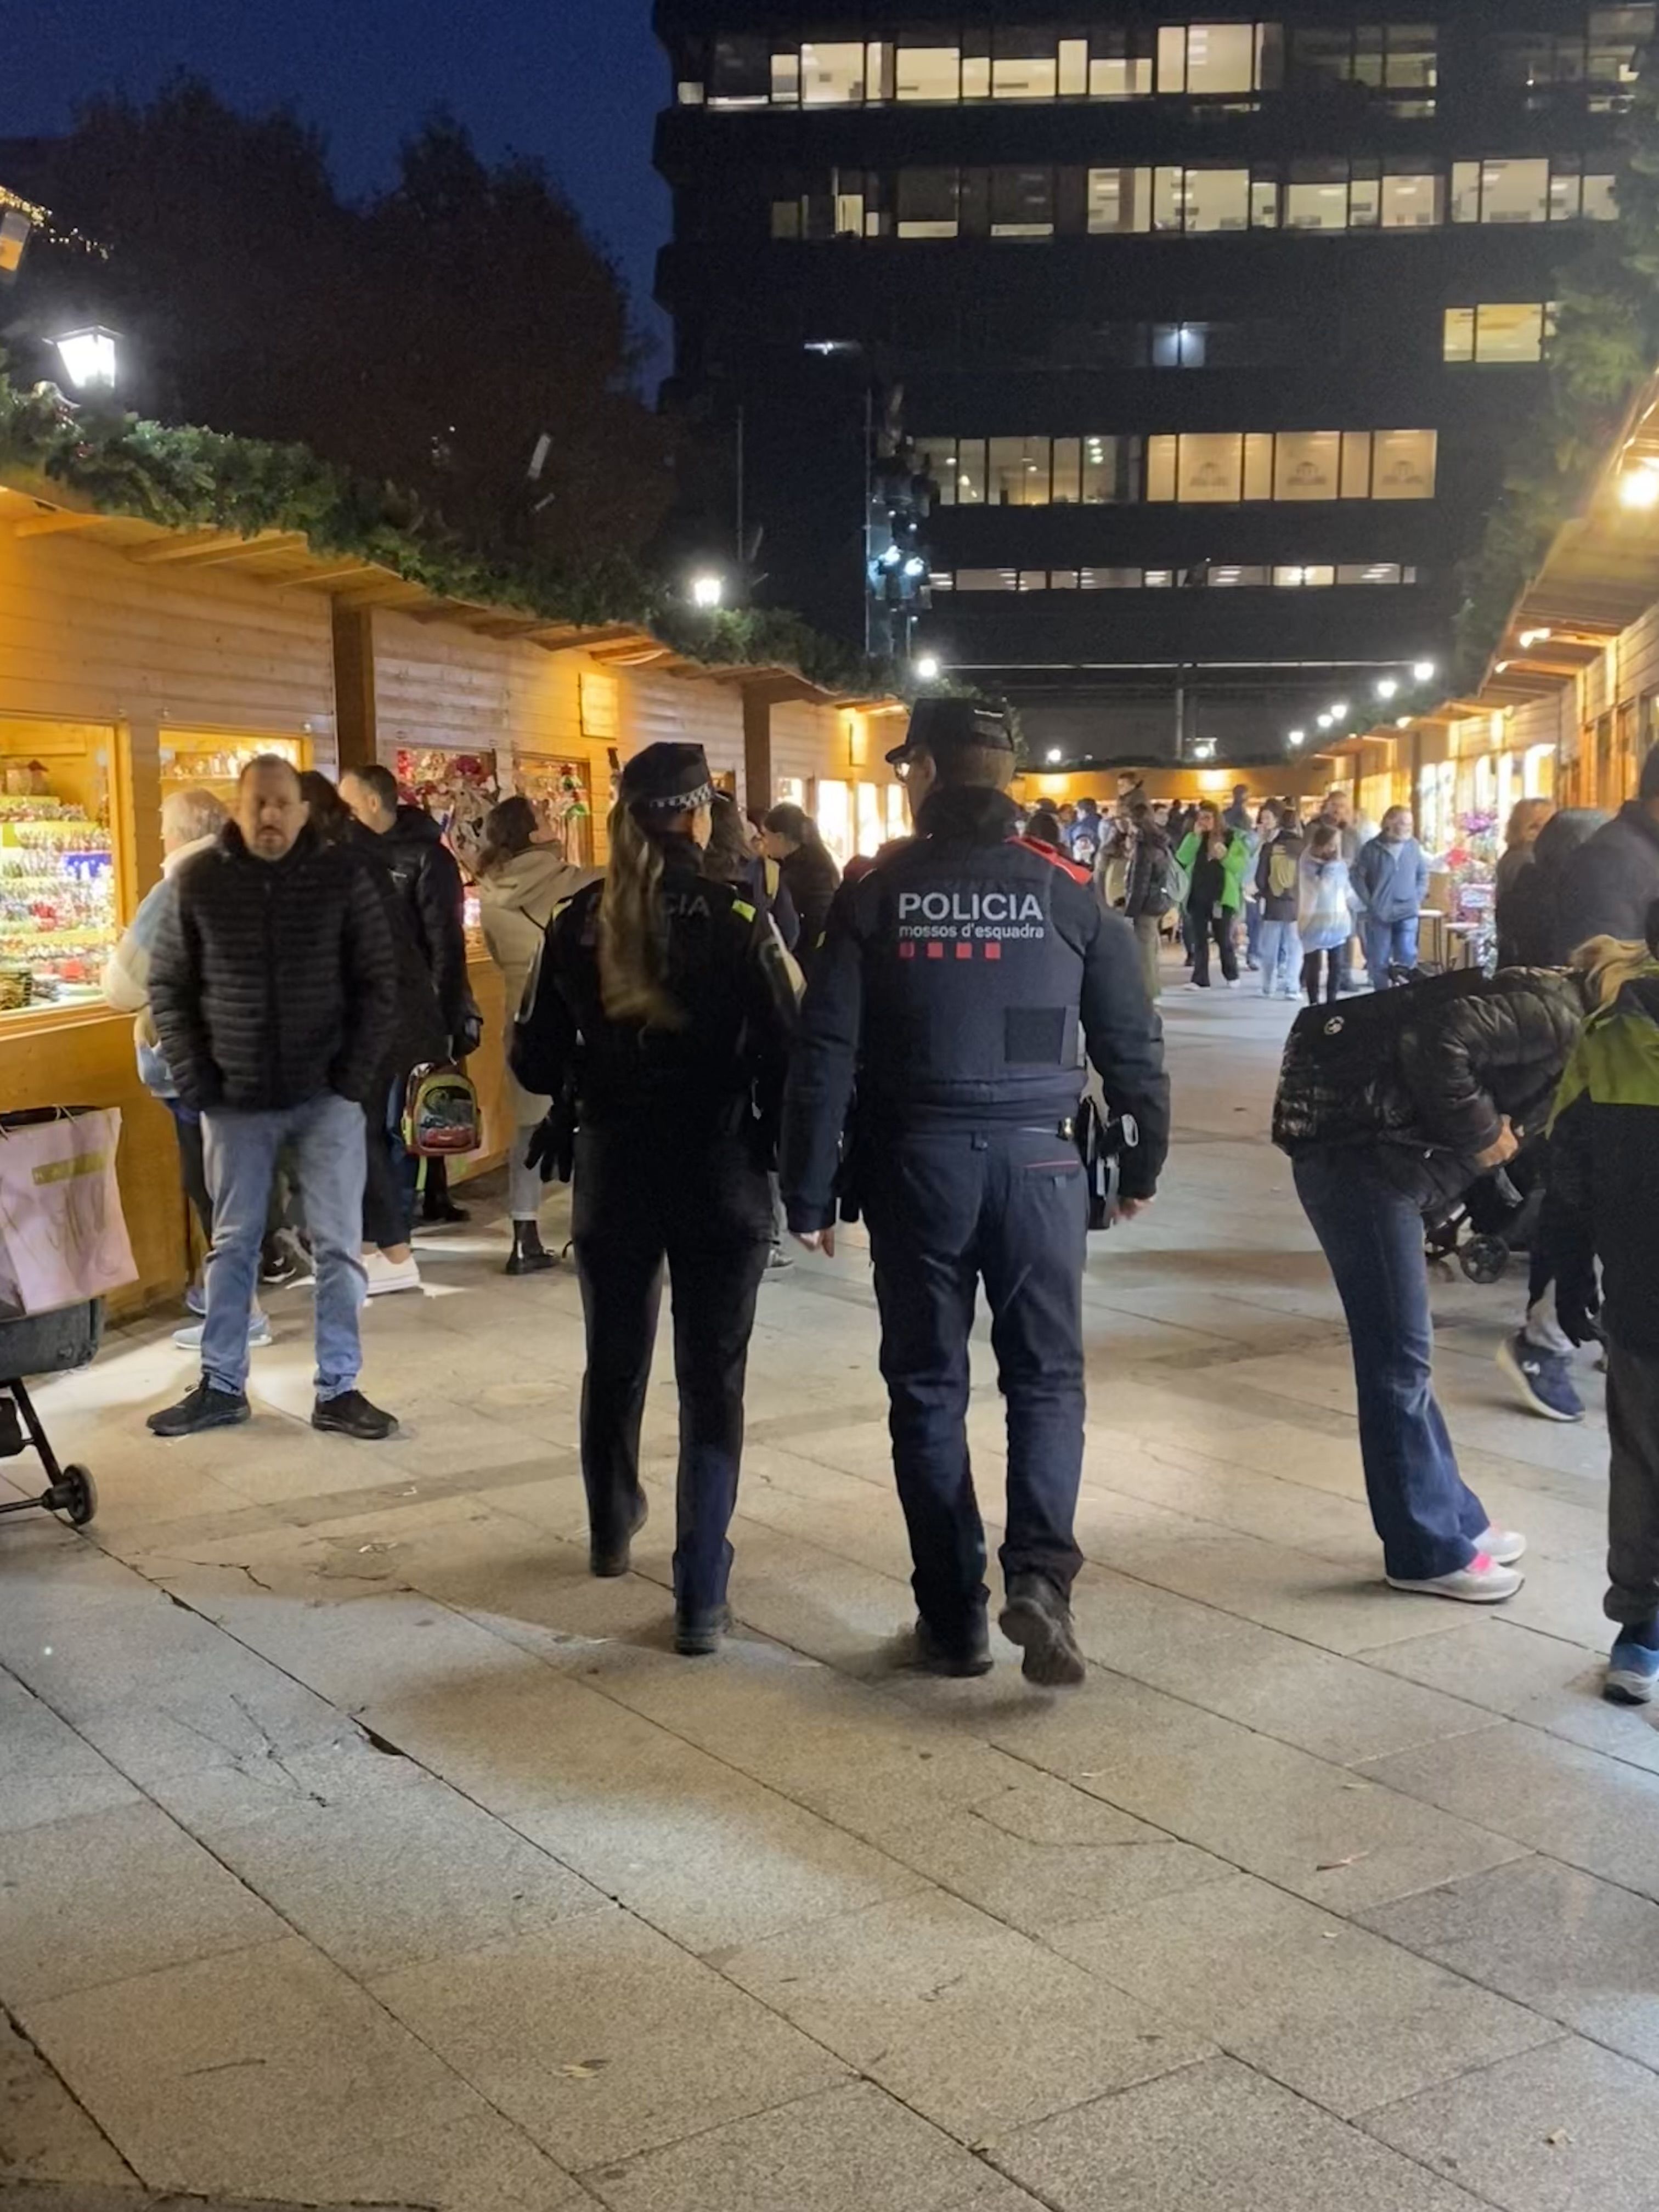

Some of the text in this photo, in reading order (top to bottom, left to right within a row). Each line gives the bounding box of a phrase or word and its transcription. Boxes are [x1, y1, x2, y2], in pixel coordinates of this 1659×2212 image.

[899, 892, 1043, 921] POLICIA
[899, 922, 1045, 940] mossos d'esquadra
